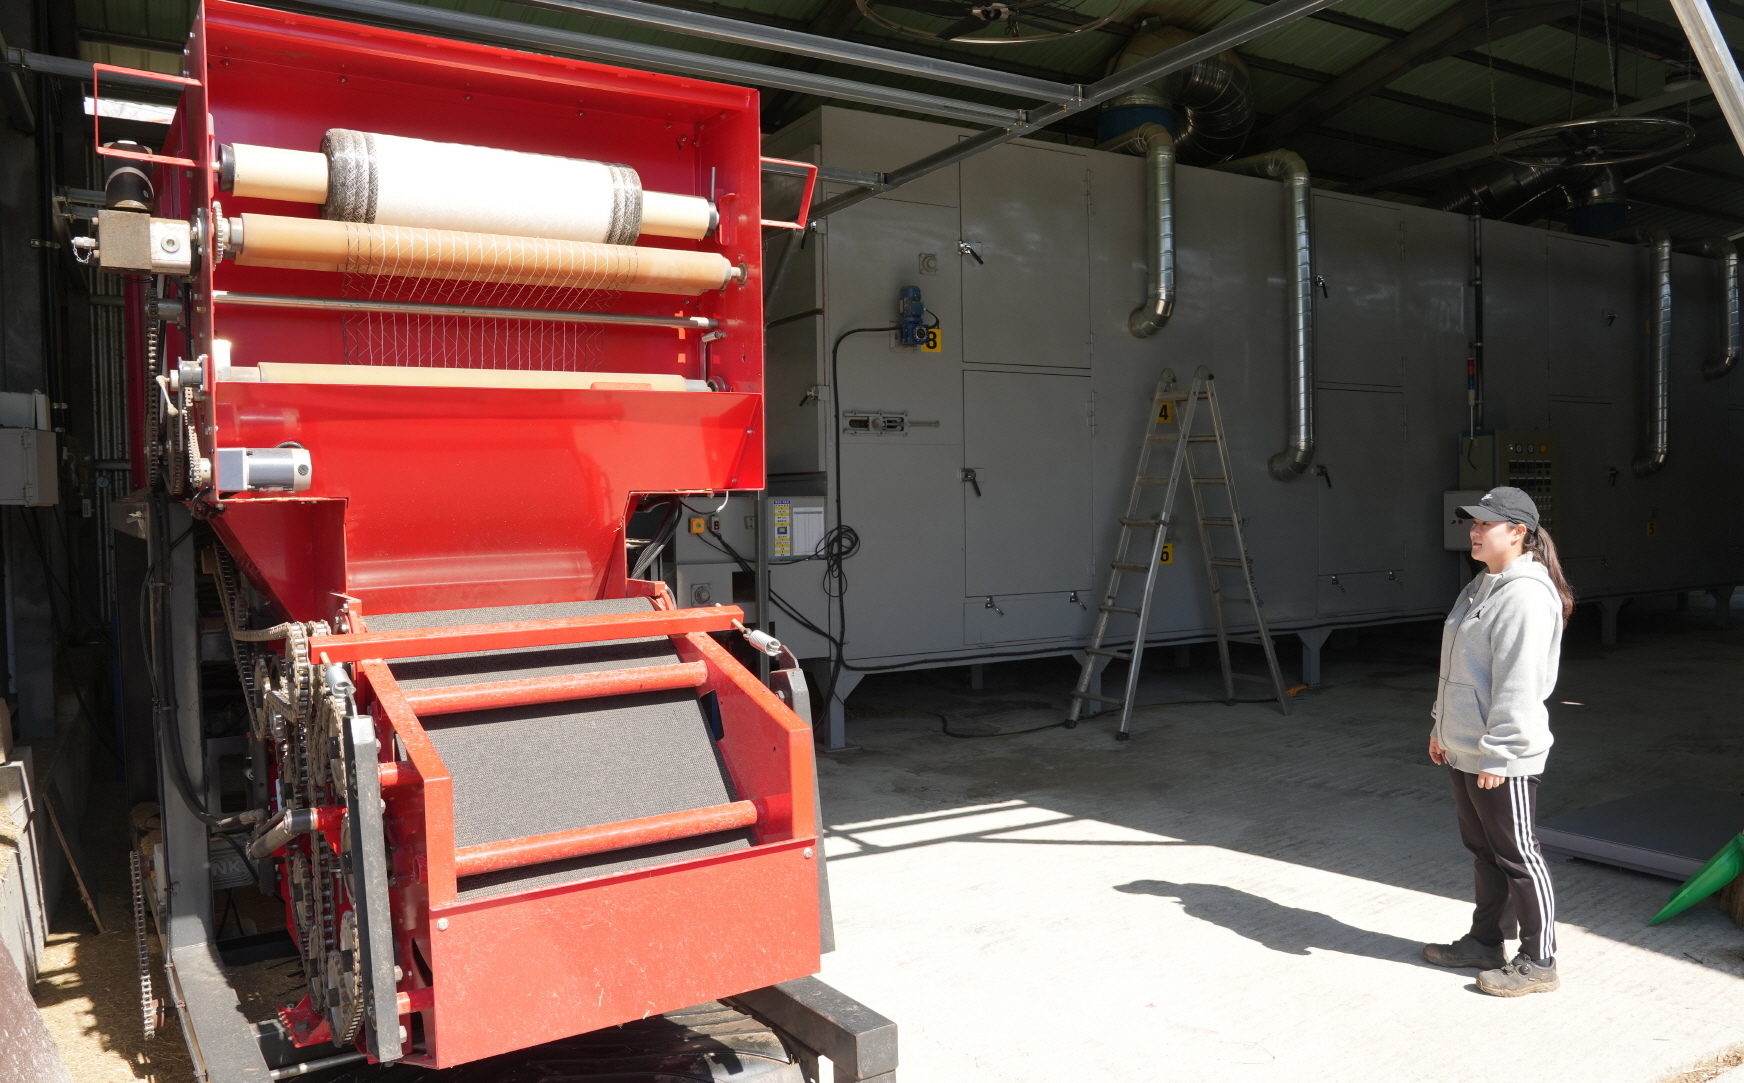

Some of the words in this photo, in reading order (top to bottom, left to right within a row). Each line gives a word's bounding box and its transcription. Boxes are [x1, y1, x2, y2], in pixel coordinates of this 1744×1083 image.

[926, 330, 937, 349] 8
[1159, 404, 1169, 420] 4
[1649, 522, 1655, 535] 5
